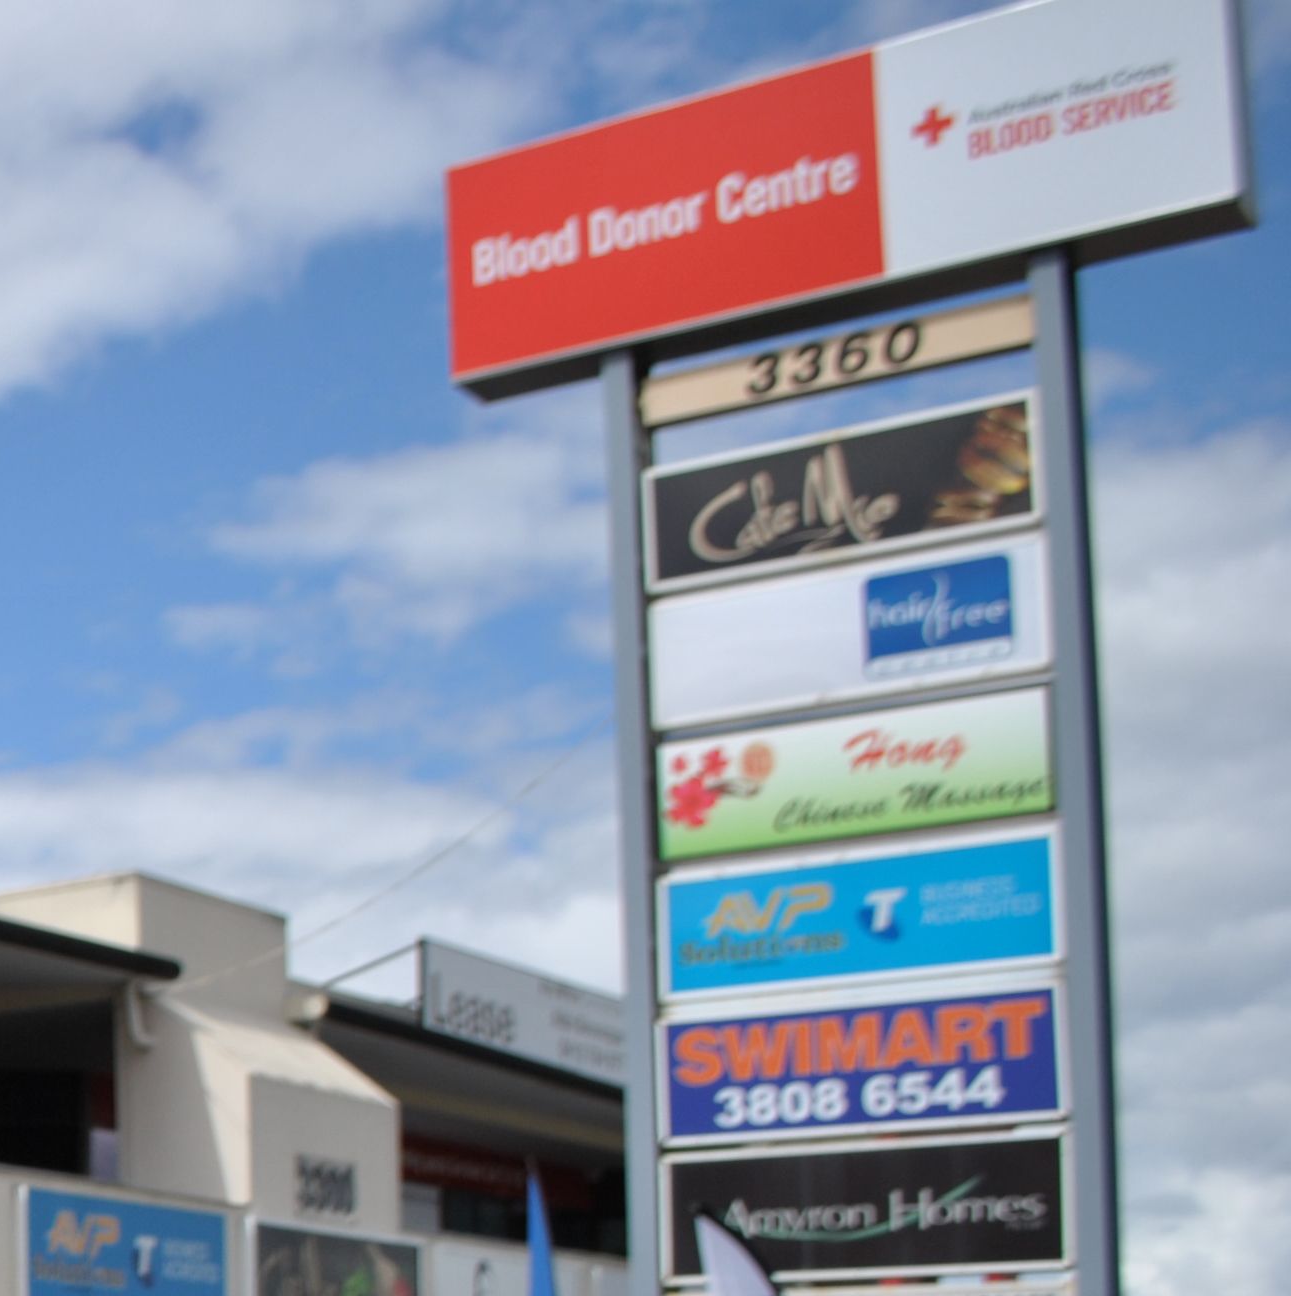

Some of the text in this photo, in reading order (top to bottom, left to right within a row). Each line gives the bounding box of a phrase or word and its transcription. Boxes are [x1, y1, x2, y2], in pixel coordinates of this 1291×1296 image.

[967, 77, 1178, 160] BLOOD SERVICE
[472, 152, 859, 287] Blood Donor Centre
[748, 321, 920, 394] 3360
[842, 728, 966, 771] Hong
[773, 776, 1048, 833] Chinese Massage
[674, 996, 1048, 1088] SWIMART
[713, 1065, 1006, 1129] 3808 6544
[723, 1187, 1049, 1240] Amyron Homes
